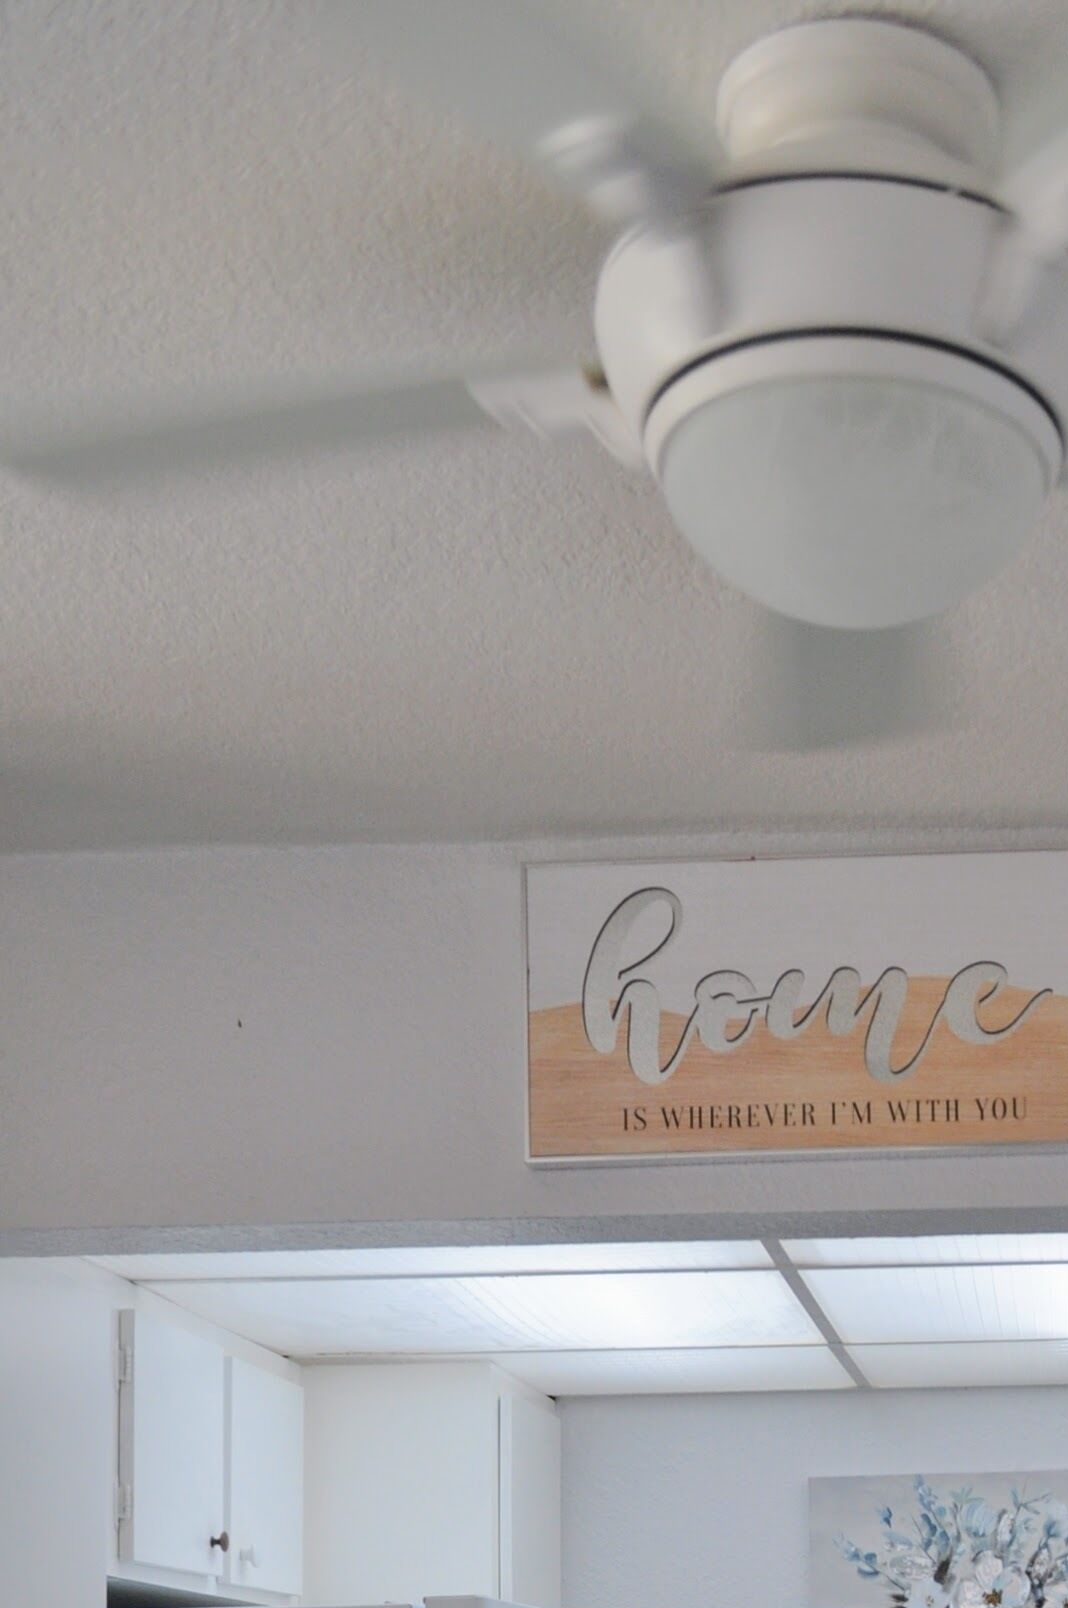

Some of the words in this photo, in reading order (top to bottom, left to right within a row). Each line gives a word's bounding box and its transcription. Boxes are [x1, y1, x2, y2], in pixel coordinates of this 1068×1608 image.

[582, 886, 1054, 1086] home
[622, 1106, 648, 1132] IS
[660, 1102, 817, 1130] WHEREVER
[831, 1100, 872, 1125] I'M
[887, 1098, 960, 1123] WITH
[975, 1096, 1028, 1121] YOU
